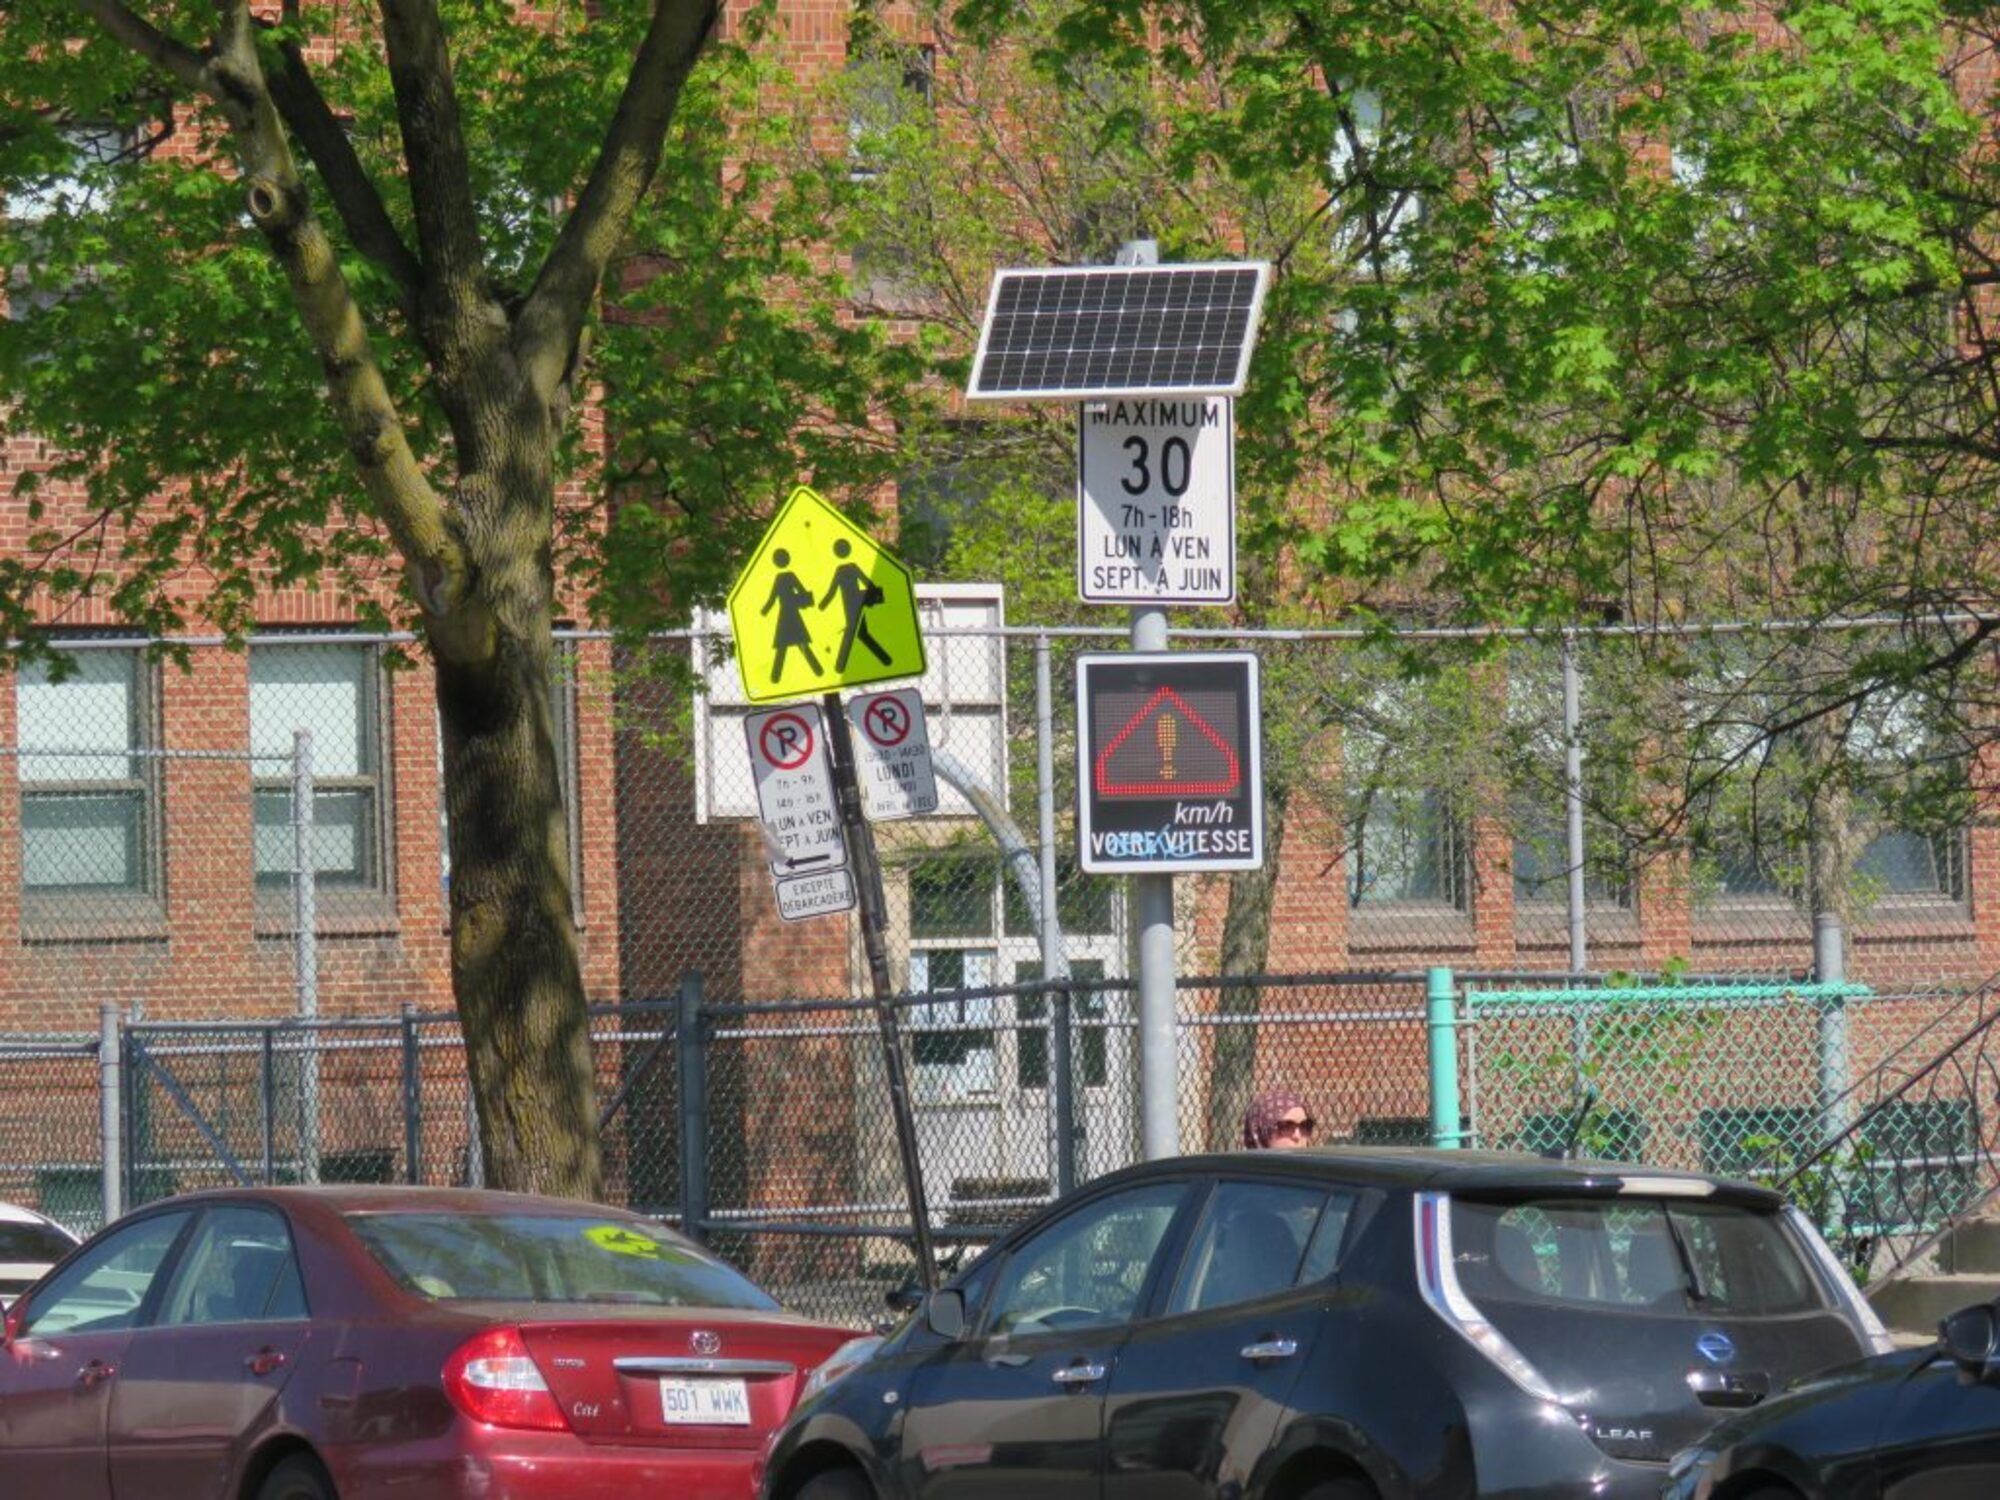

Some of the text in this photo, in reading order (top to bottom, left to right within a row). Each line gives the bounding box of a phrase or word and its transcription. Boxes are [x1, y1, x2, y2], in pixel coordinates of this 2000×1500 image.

[1092, 402, 1218, 427] MAXIMUM
[1121, 435, 1191, 497] 30
[1104, 535, 1141, 558] LUN
[1172, 537, 1210, 558] VEN
[1179, 568, 1222, 591] JUIN
[806, 810, 831, 824] VEN
[1175, 801, 1233, 825] km/h
[1092, 831, 1157, 855] VOTRE
[1164, 829, 1250, 853] VITESSE
[666, 1388, 744, 1411] 501 WWK
[1596, 1428, 1653, 1440] LEAF
